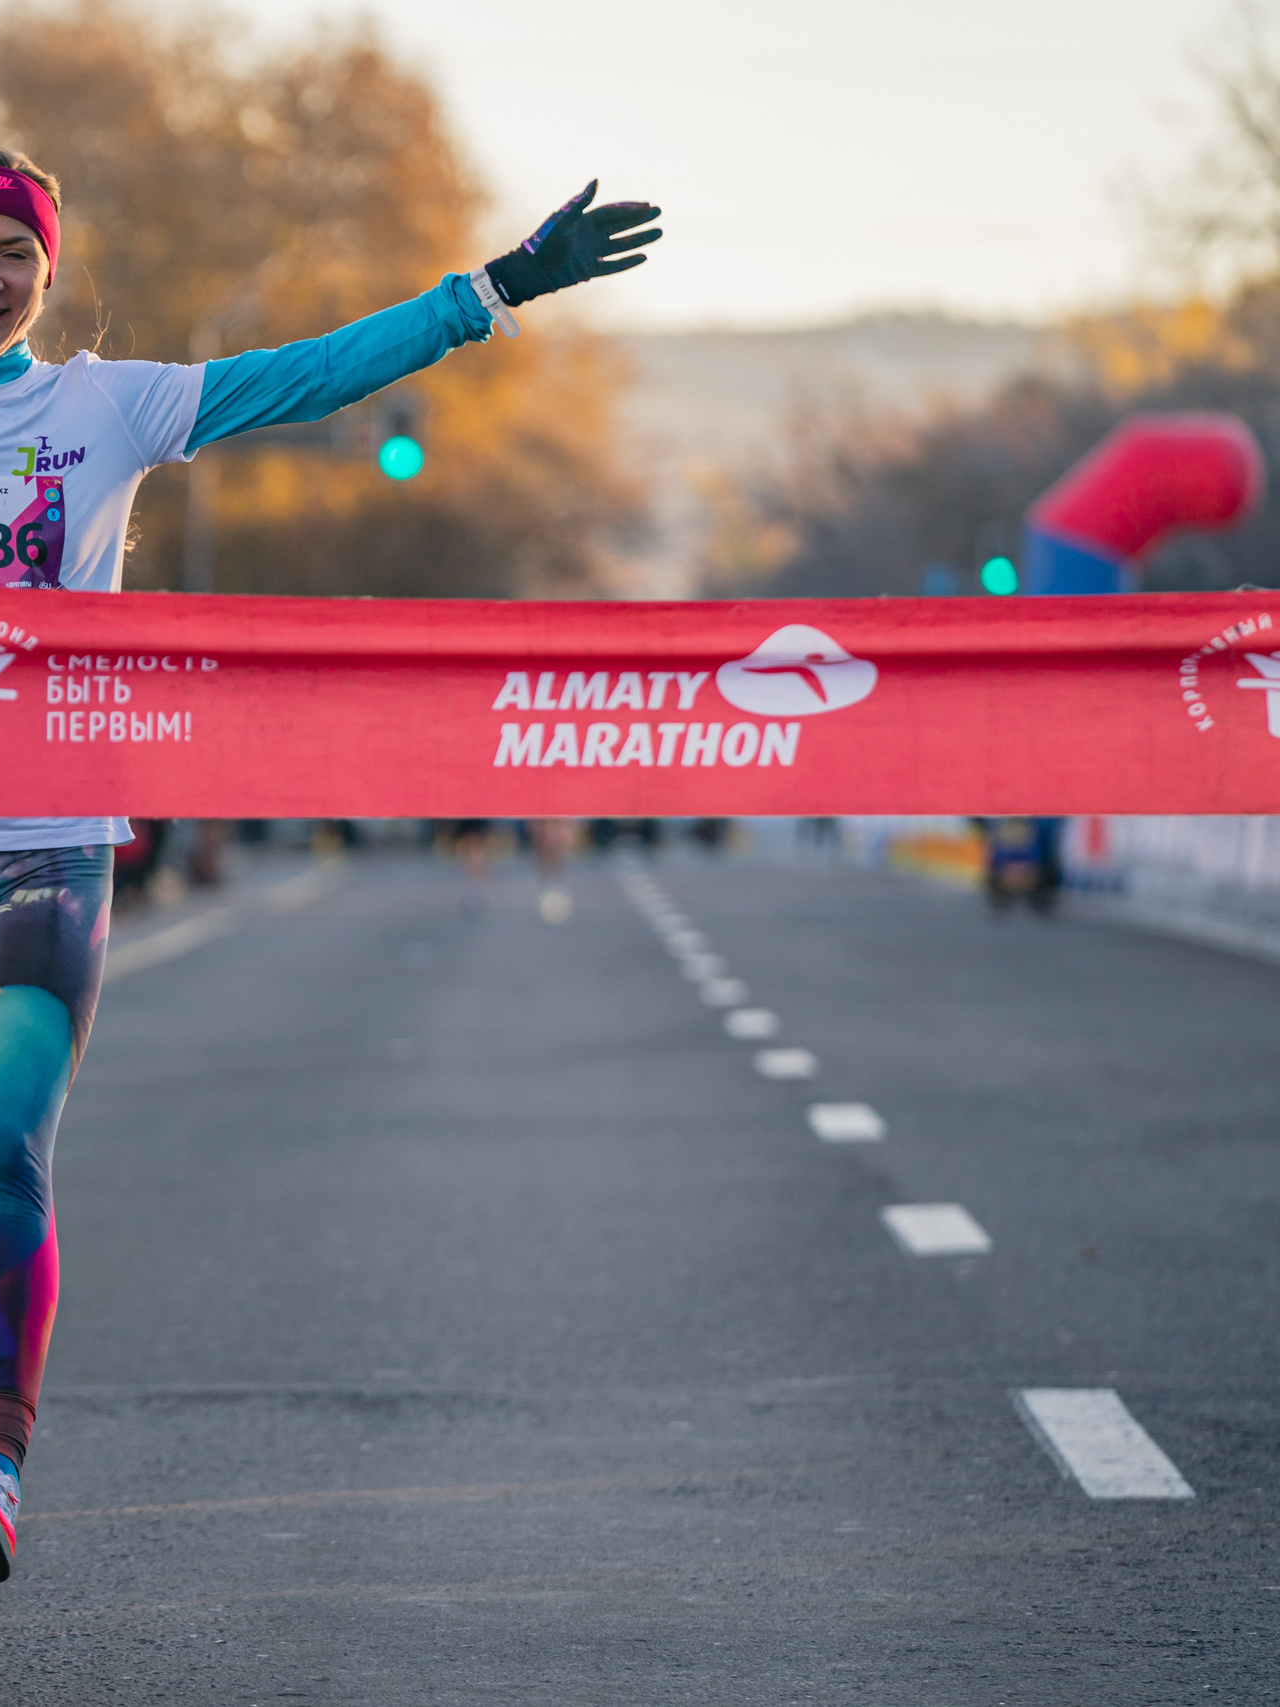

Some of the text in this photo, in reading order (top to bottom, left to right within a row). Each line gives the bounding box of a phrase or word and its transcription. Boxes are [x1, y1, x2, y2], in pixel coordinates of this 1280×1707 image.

[47, 654, 219, 672] СМЕЛОСТЬ
[1179, 612, 1273, 732] КОРПОРВНЫЙ
[46, 675, 132, 704] БЫТЬ
[491, 671, 710, 711] ALMATY
[46, 711, 192, 742] ПЕРВЫМ!
[493, 722, 801, 767] MARATHON
